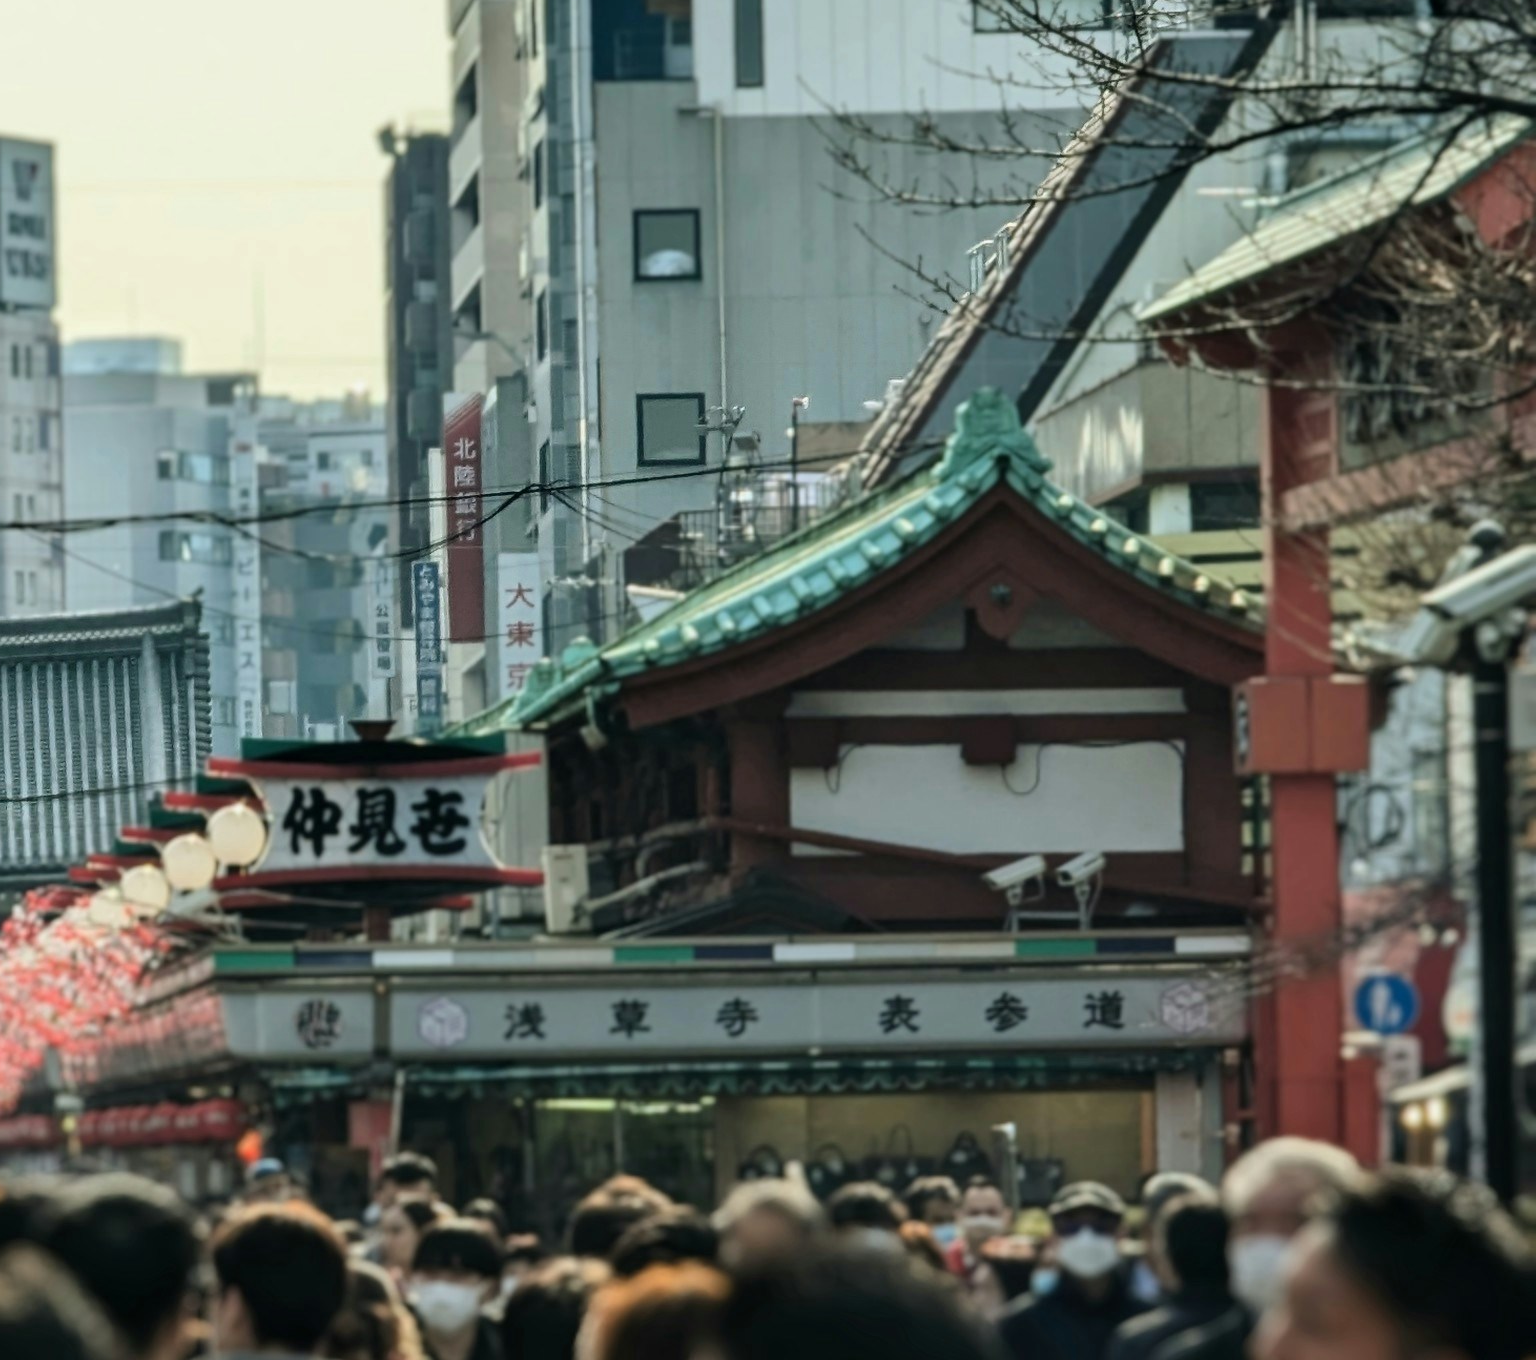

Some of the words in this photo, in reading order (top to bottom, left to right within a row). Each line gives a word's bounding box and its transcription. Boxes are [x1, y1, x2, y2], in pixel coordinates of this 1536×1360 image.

[453, 437, 477, 541] 北陸銀行
[283, 785, 471, 858] 仲見世
